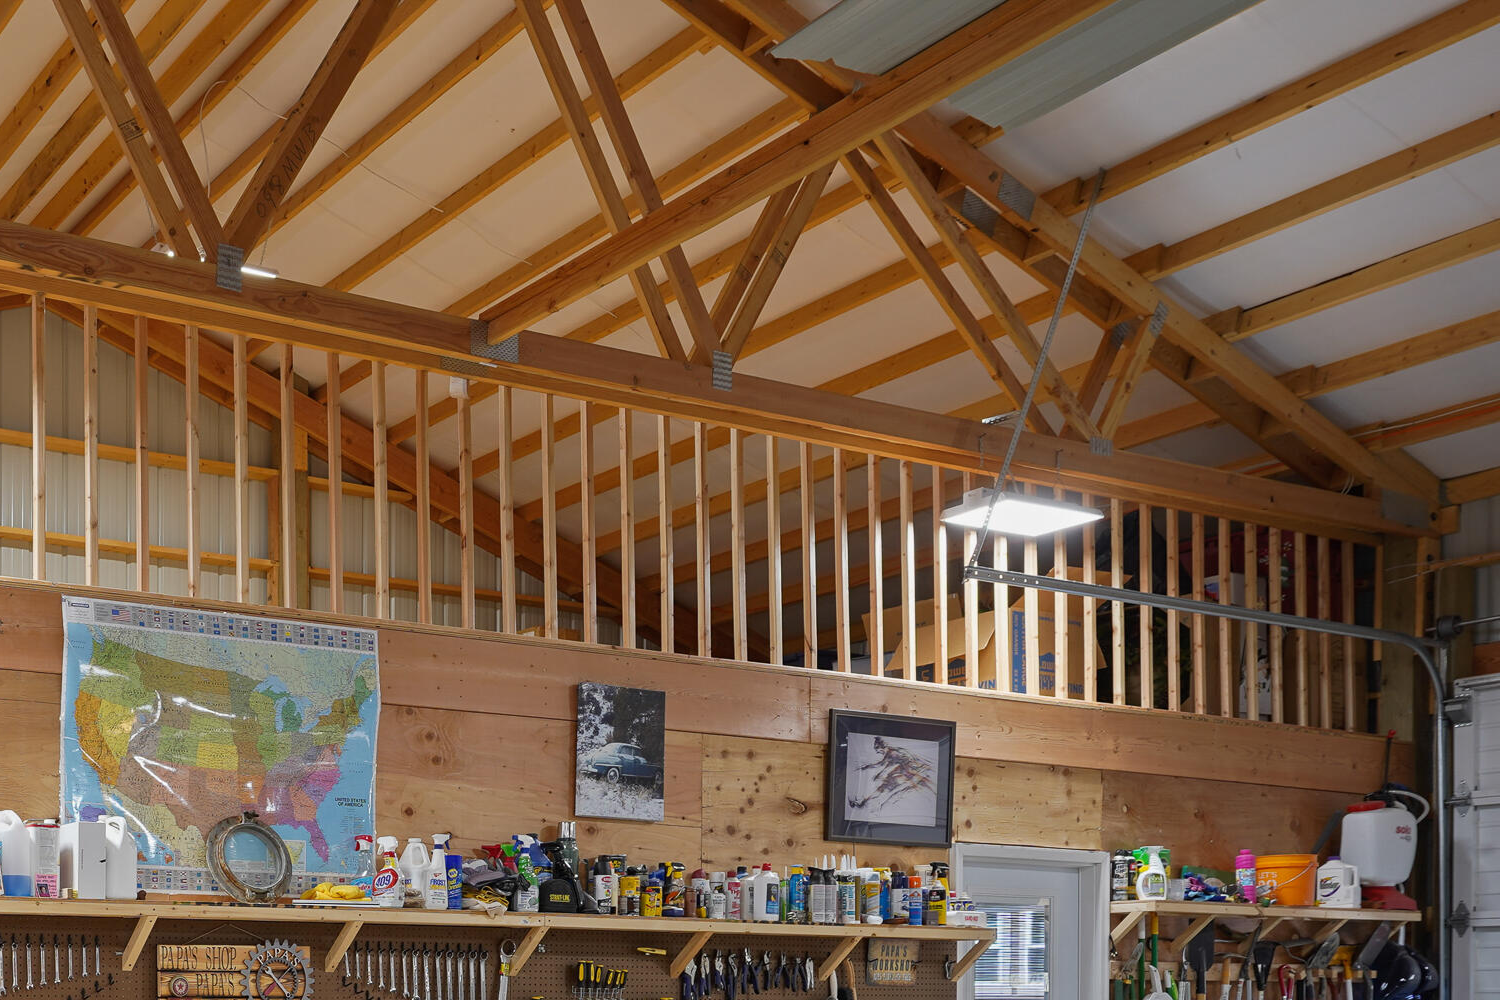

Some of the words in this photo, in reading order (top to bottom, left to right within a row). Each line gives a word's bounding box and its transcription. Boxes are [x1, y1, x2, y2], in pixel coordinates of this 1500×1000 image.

[375, 874, 391, 887] 409
[161, 945, 198, 970] PAPA'S
[257, 947, 300, 967] PAPA'S
[880, 944, 908, 957] PAPA'S
[196, 973, 235, 997] PAPA'S
